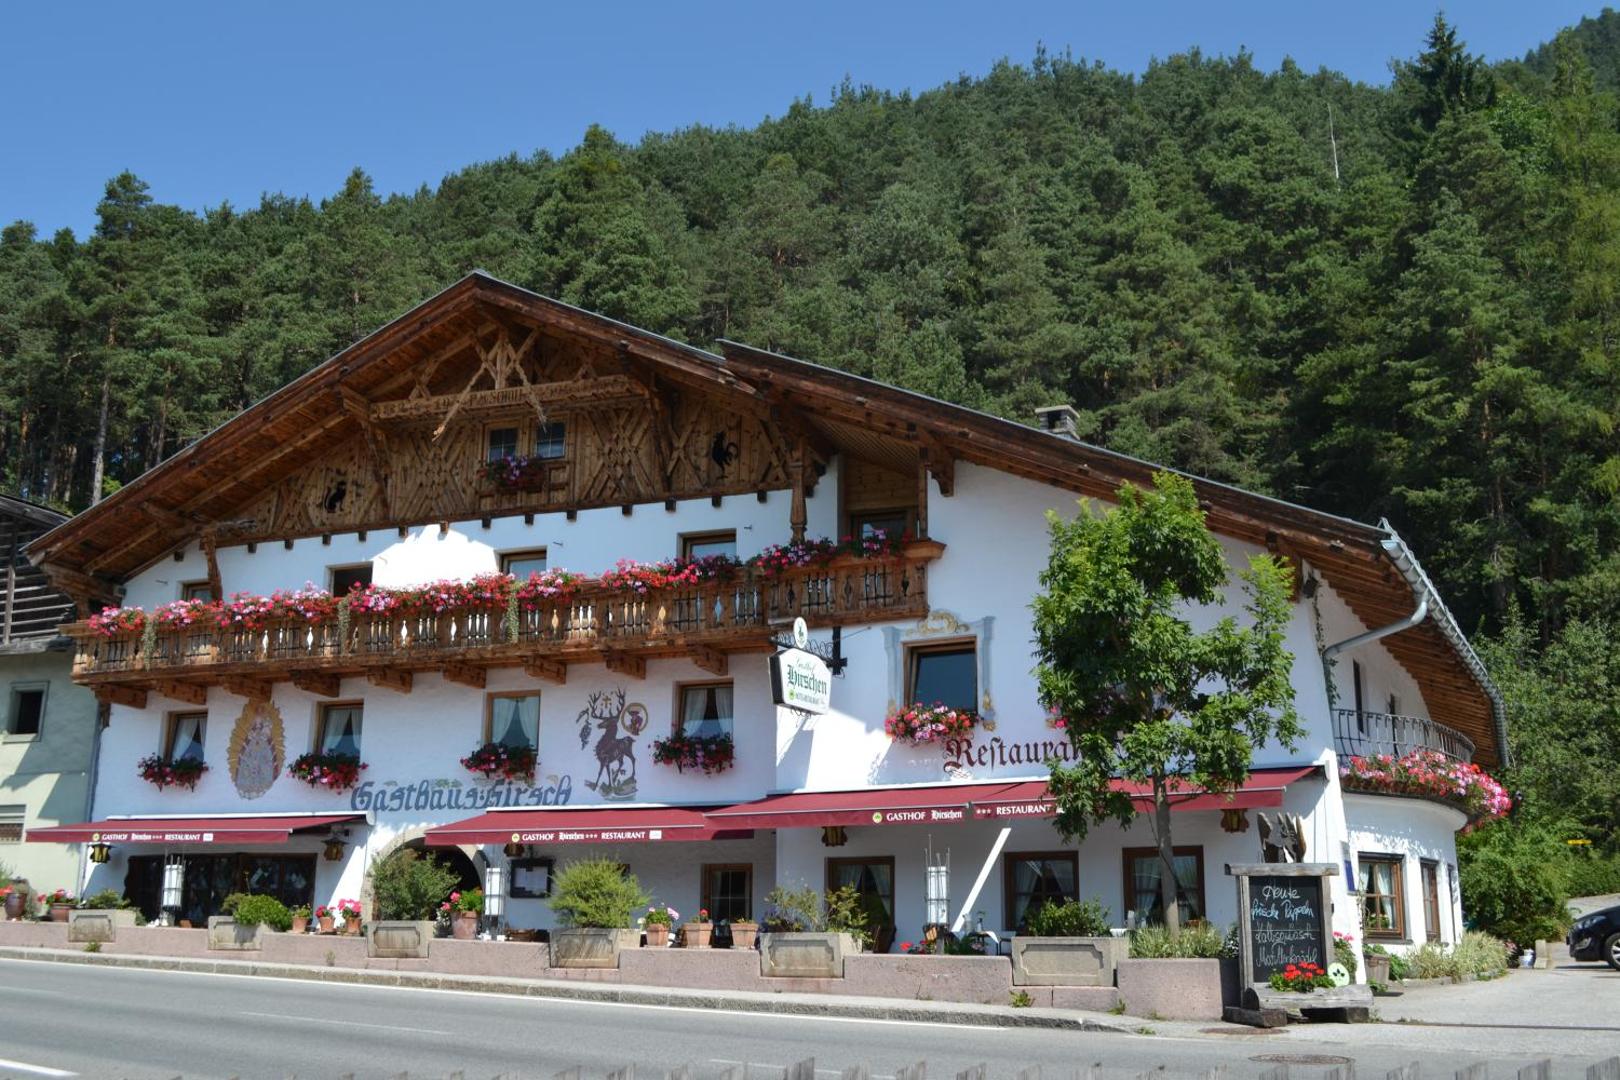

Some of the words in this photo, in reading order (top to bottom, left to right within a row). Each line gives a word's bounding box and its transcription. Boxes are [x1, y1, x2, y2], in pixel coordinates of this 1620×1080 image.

[787, 664, 827, 695] Hirschen
[886, 812, 926, 821] GASTHOF
[931, 810, 962, 820] Hirschen
[996, 804, 1051, 815] RESTAURANT
[1262, 881, 1301, 900] Heute
